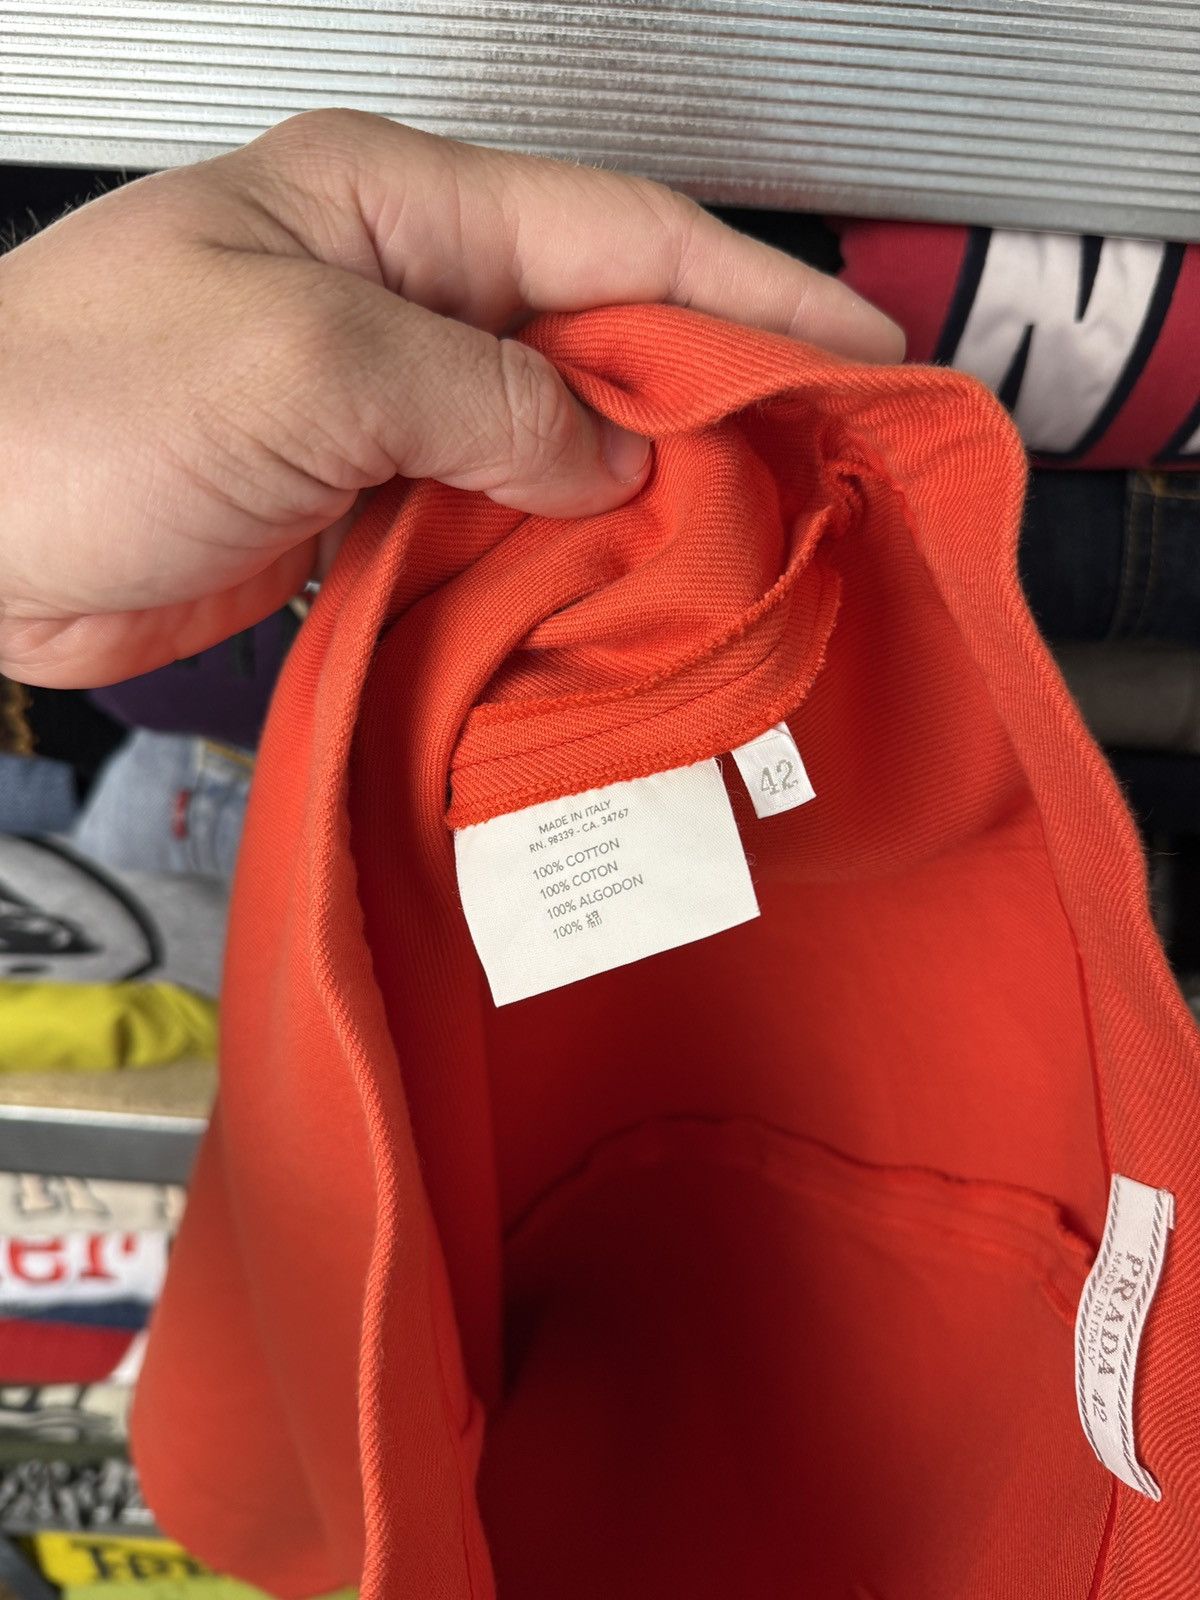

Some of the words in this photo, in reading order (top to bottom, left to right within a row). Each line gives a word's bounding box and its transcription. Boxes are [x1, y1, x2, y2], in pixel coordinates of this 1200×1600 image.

[760, 758, 799, 796] 42
[529, 840, 547, 853] RN.
[548, 828, 574, 845] 98339
[582, 821, 600, 833] CA.
[601, 808, 629, 825] 34767
[538, 815, 569, 834] MADE
[570, 810, 583, 822] IN
[585, 799, 611, 817] ITALY
[533, 860, 564, 880] 100%
[566, 838, 620, 867] COTTON
[540, 879, 570, 899] 100%
[572, 860, 618, 886] COTON
[547, 899, 577, 919] 100%
[580, 873, 644, 908] ALGODON
[553, 919, 583, 939] 100%
[1098, 1251, 1122, 1296] MADE
[1093, 1300, 1104, 1317] IN
[1098, 1250, 1144, 1374] PRADA
[1088, 1319, 1099, 1367] ITALY
[1091, 1388, 1107, 1422] 42
